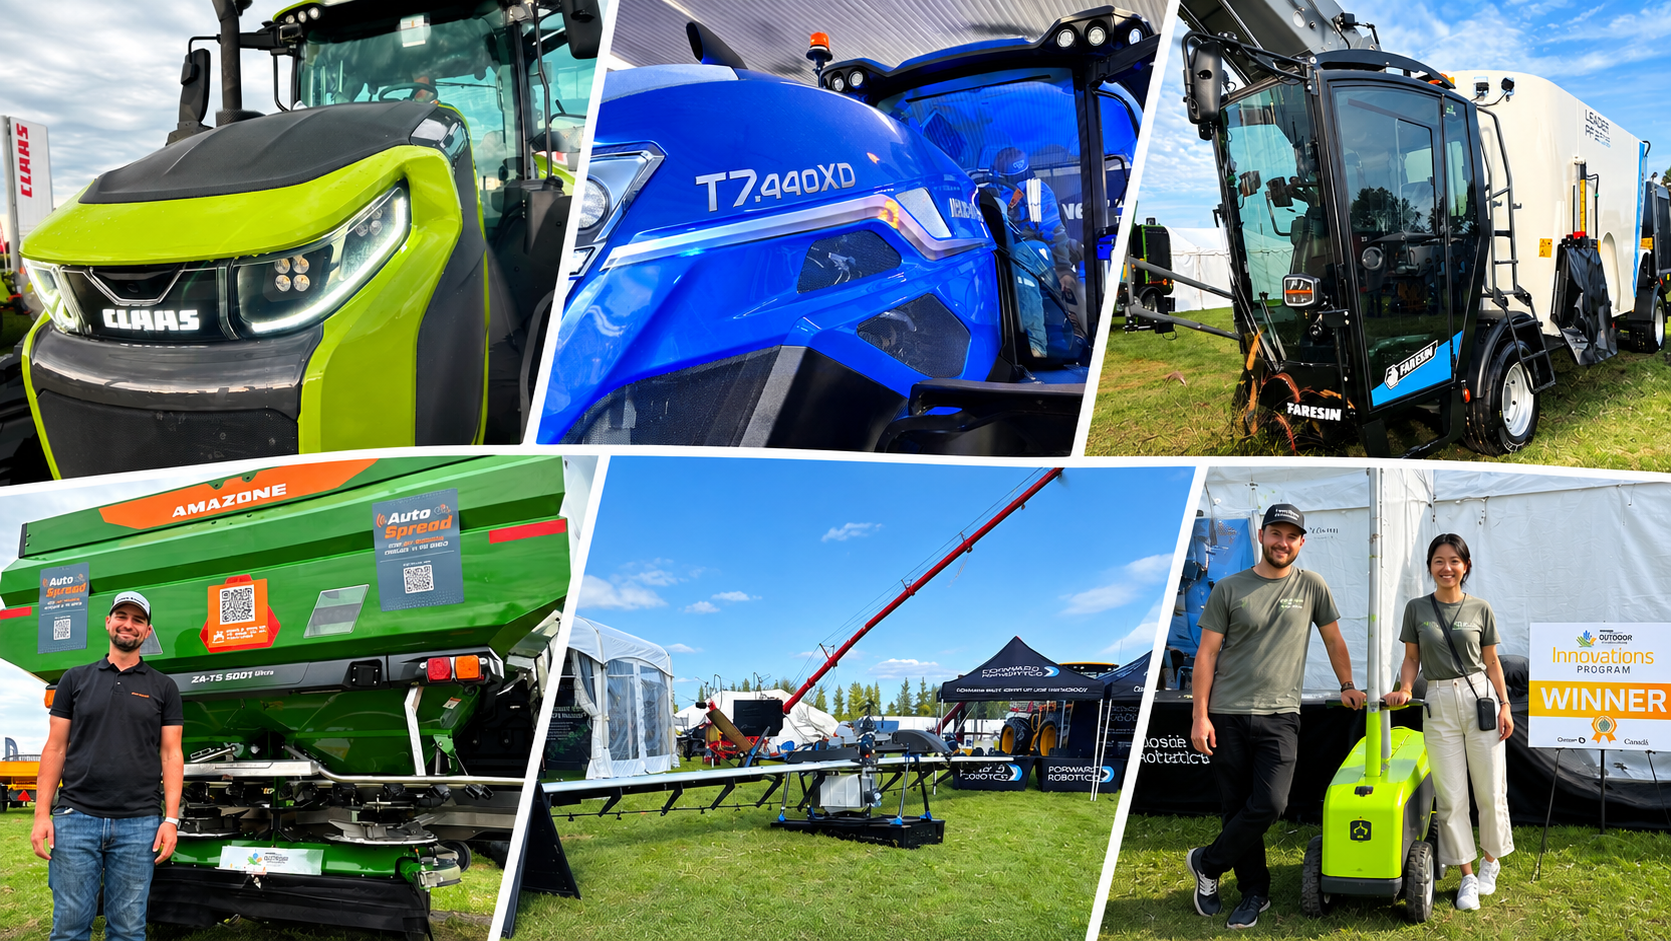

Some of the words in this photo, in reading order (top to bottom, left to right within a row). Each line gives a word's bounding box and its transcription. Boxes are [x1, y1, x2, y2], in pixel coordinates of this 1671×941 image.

[16, 122, 32, 198] CLAAS
[695, 162, 856, 212] T7.440XD
[102, 308, 200, 331] CLAAS
[1286, 402, 1342, 421] FARESIN
[172, 483, 287, 518] AMAZONE
[384, 515, 453, 540] Spread
[387, 509, 431, 525] Auto
[49, 576, 74, 586] Auto
[1552, 646, 1655, 665] Innovations
[191, 674, 223, 684] ZA-TS
[1576, 665, 1631, 674] PROGRAM
[1540, 687, 1667, 713] WINNER
